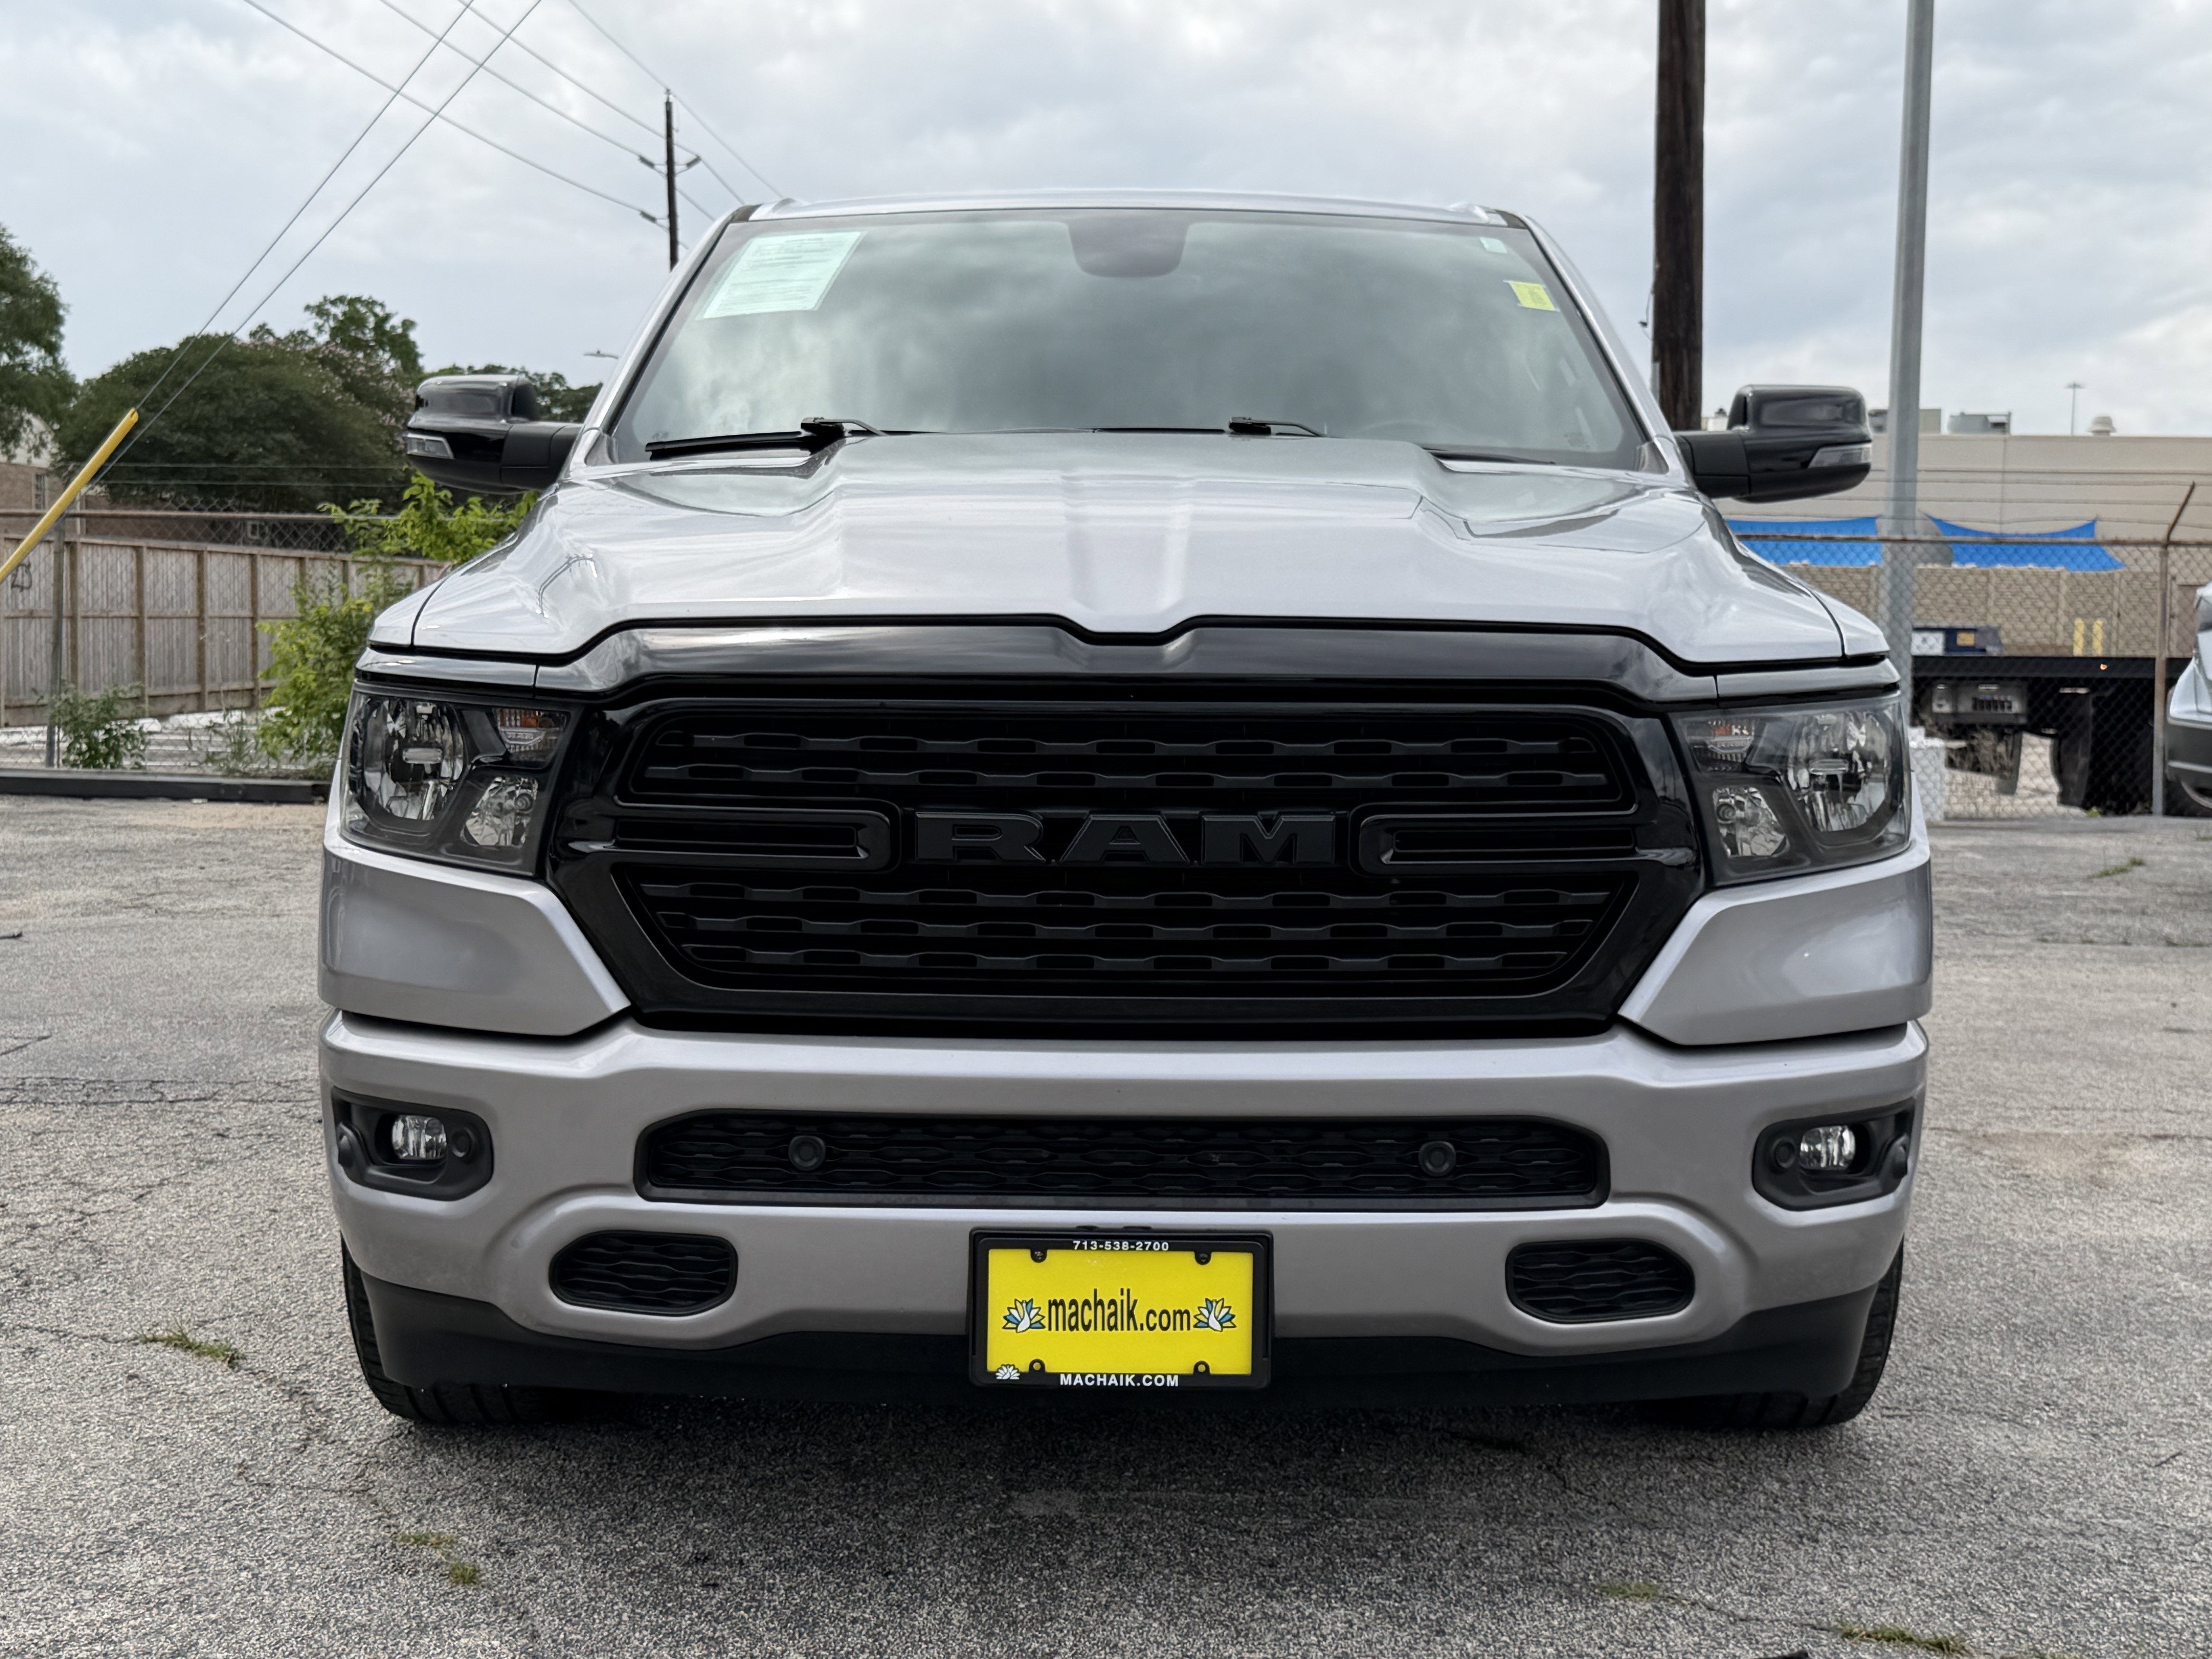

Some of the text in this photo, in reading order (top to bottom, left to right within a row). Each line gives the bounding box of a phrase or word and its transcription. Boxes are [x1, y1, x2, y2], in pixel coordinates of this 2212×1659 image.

[916, 811, 1335, 863] RAM
[1073, 1240, 1170, 1251] 713-538-2700
[1048, 1288, 1191, 1331] machaik.com
[1060, 1374, 1179, 1387] MACHAIK.COM
